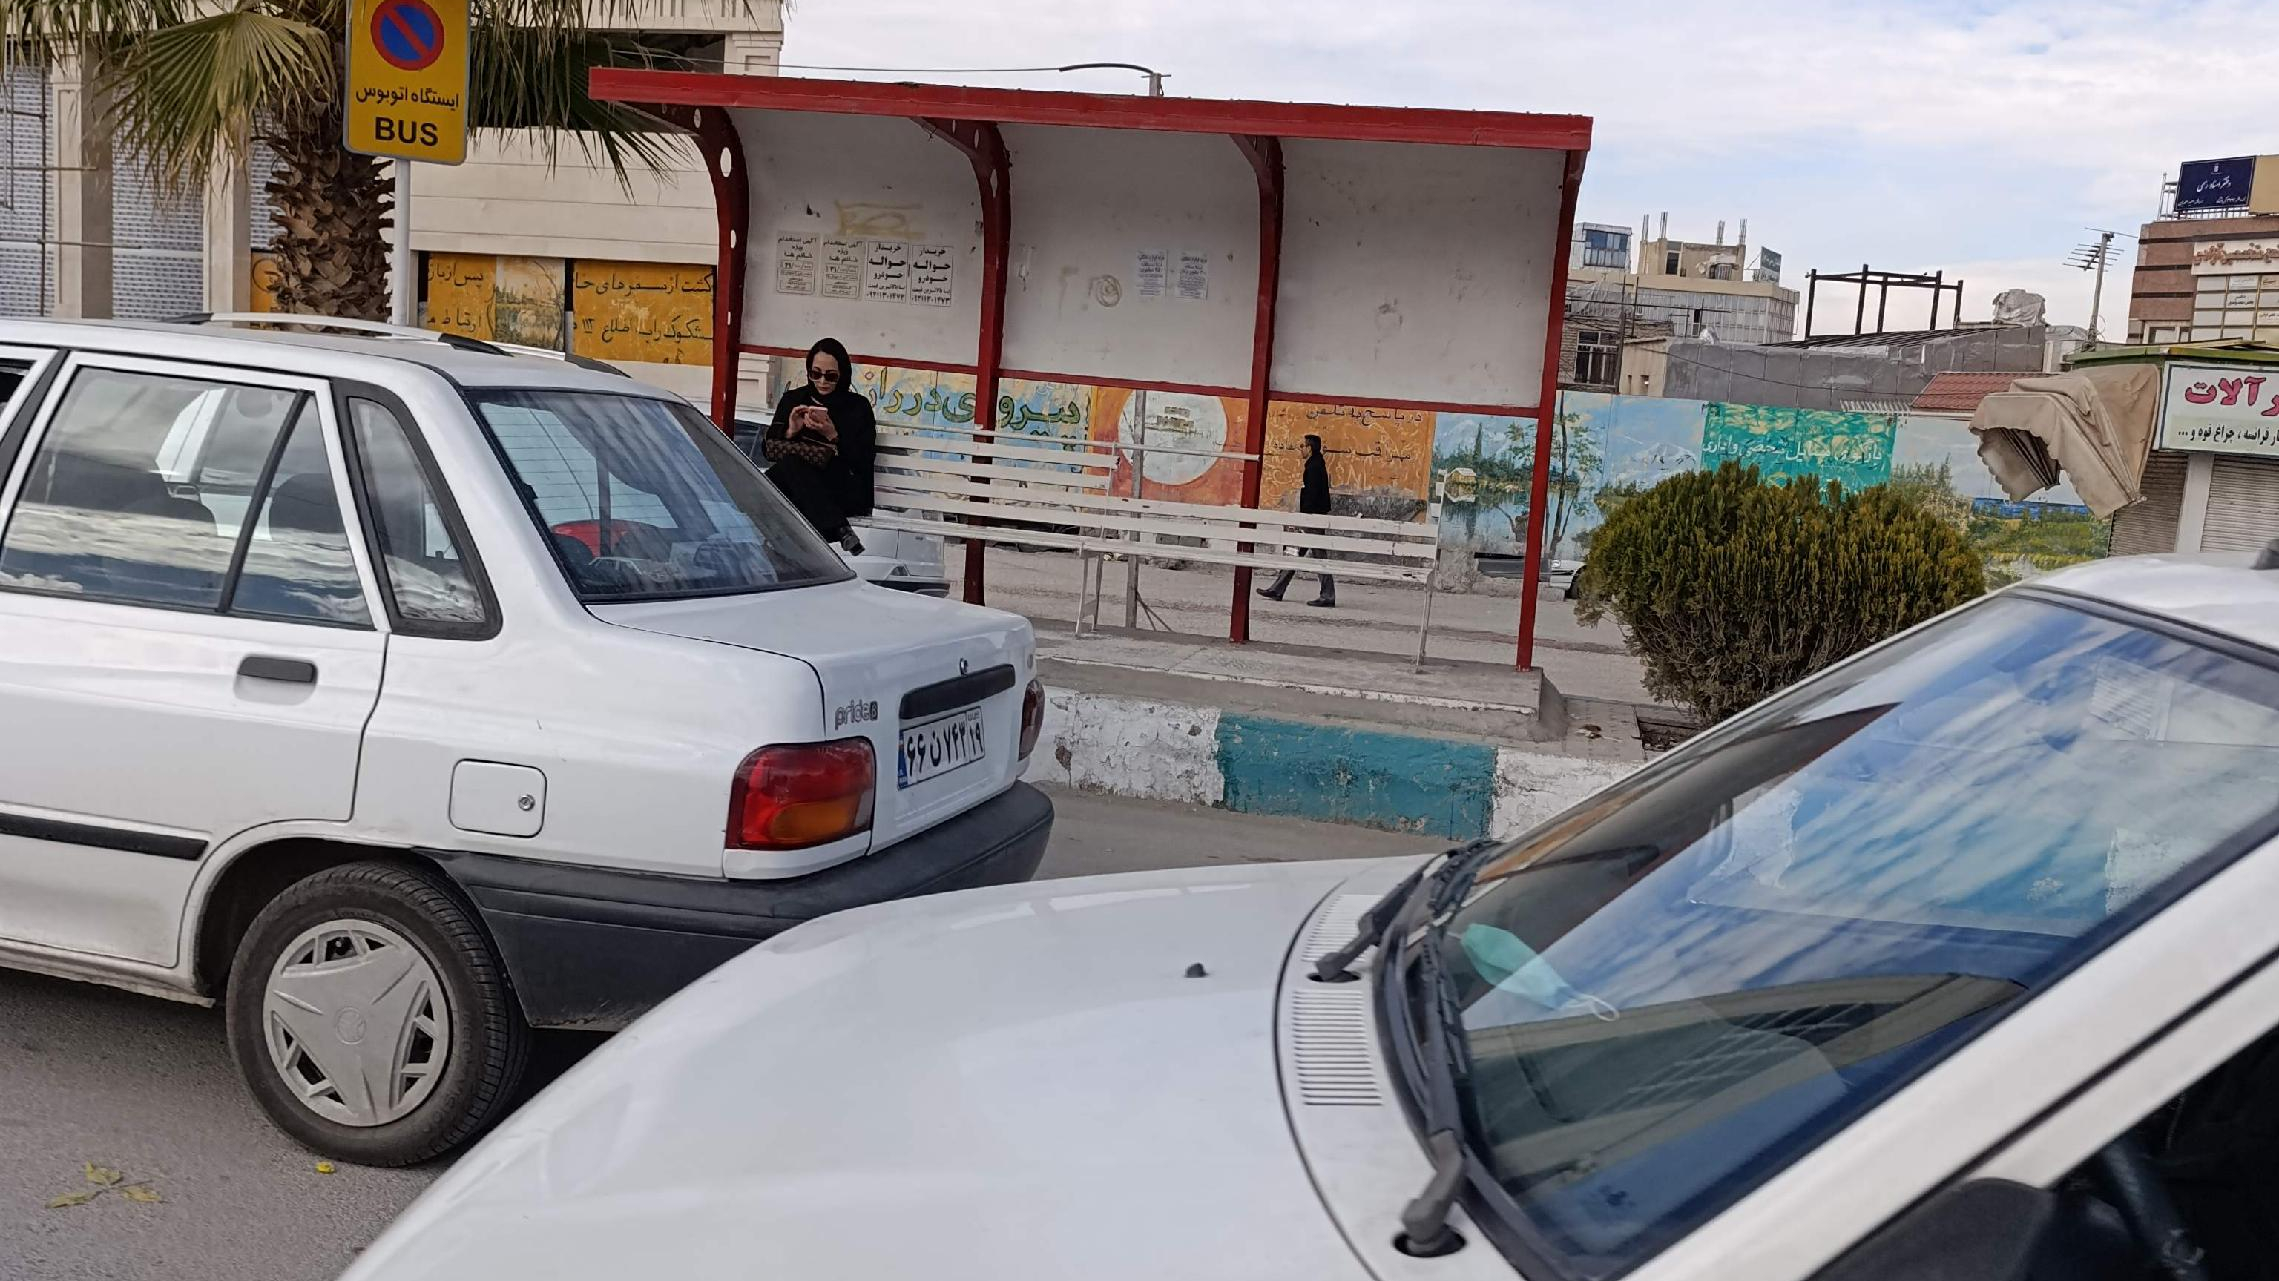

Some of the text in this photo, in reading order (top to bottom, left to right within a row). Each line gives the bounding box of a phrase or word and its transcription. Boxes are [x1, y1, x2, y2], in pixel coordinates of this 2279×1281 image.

[356, 85, 459, 111] ایستگاه اتوبوس
[375, 117, 438, 147] BUS
[874, 243, 902, 254] خریدار
[919, 247, 946, 257] خریدار
[868, 255, 906, 269] حواله
[912, 259, 951, 273] حواله
[873, 272, 903, 280] خودرو
[918, 275, 948, 284] خودرو
[2184, 375, 2267, 407] آلات
[2198, 423, 2212, 441] قوه
[2213, 424, 2235, 444] چراغ
[2243, 426, 2270, 446] فرانسه
